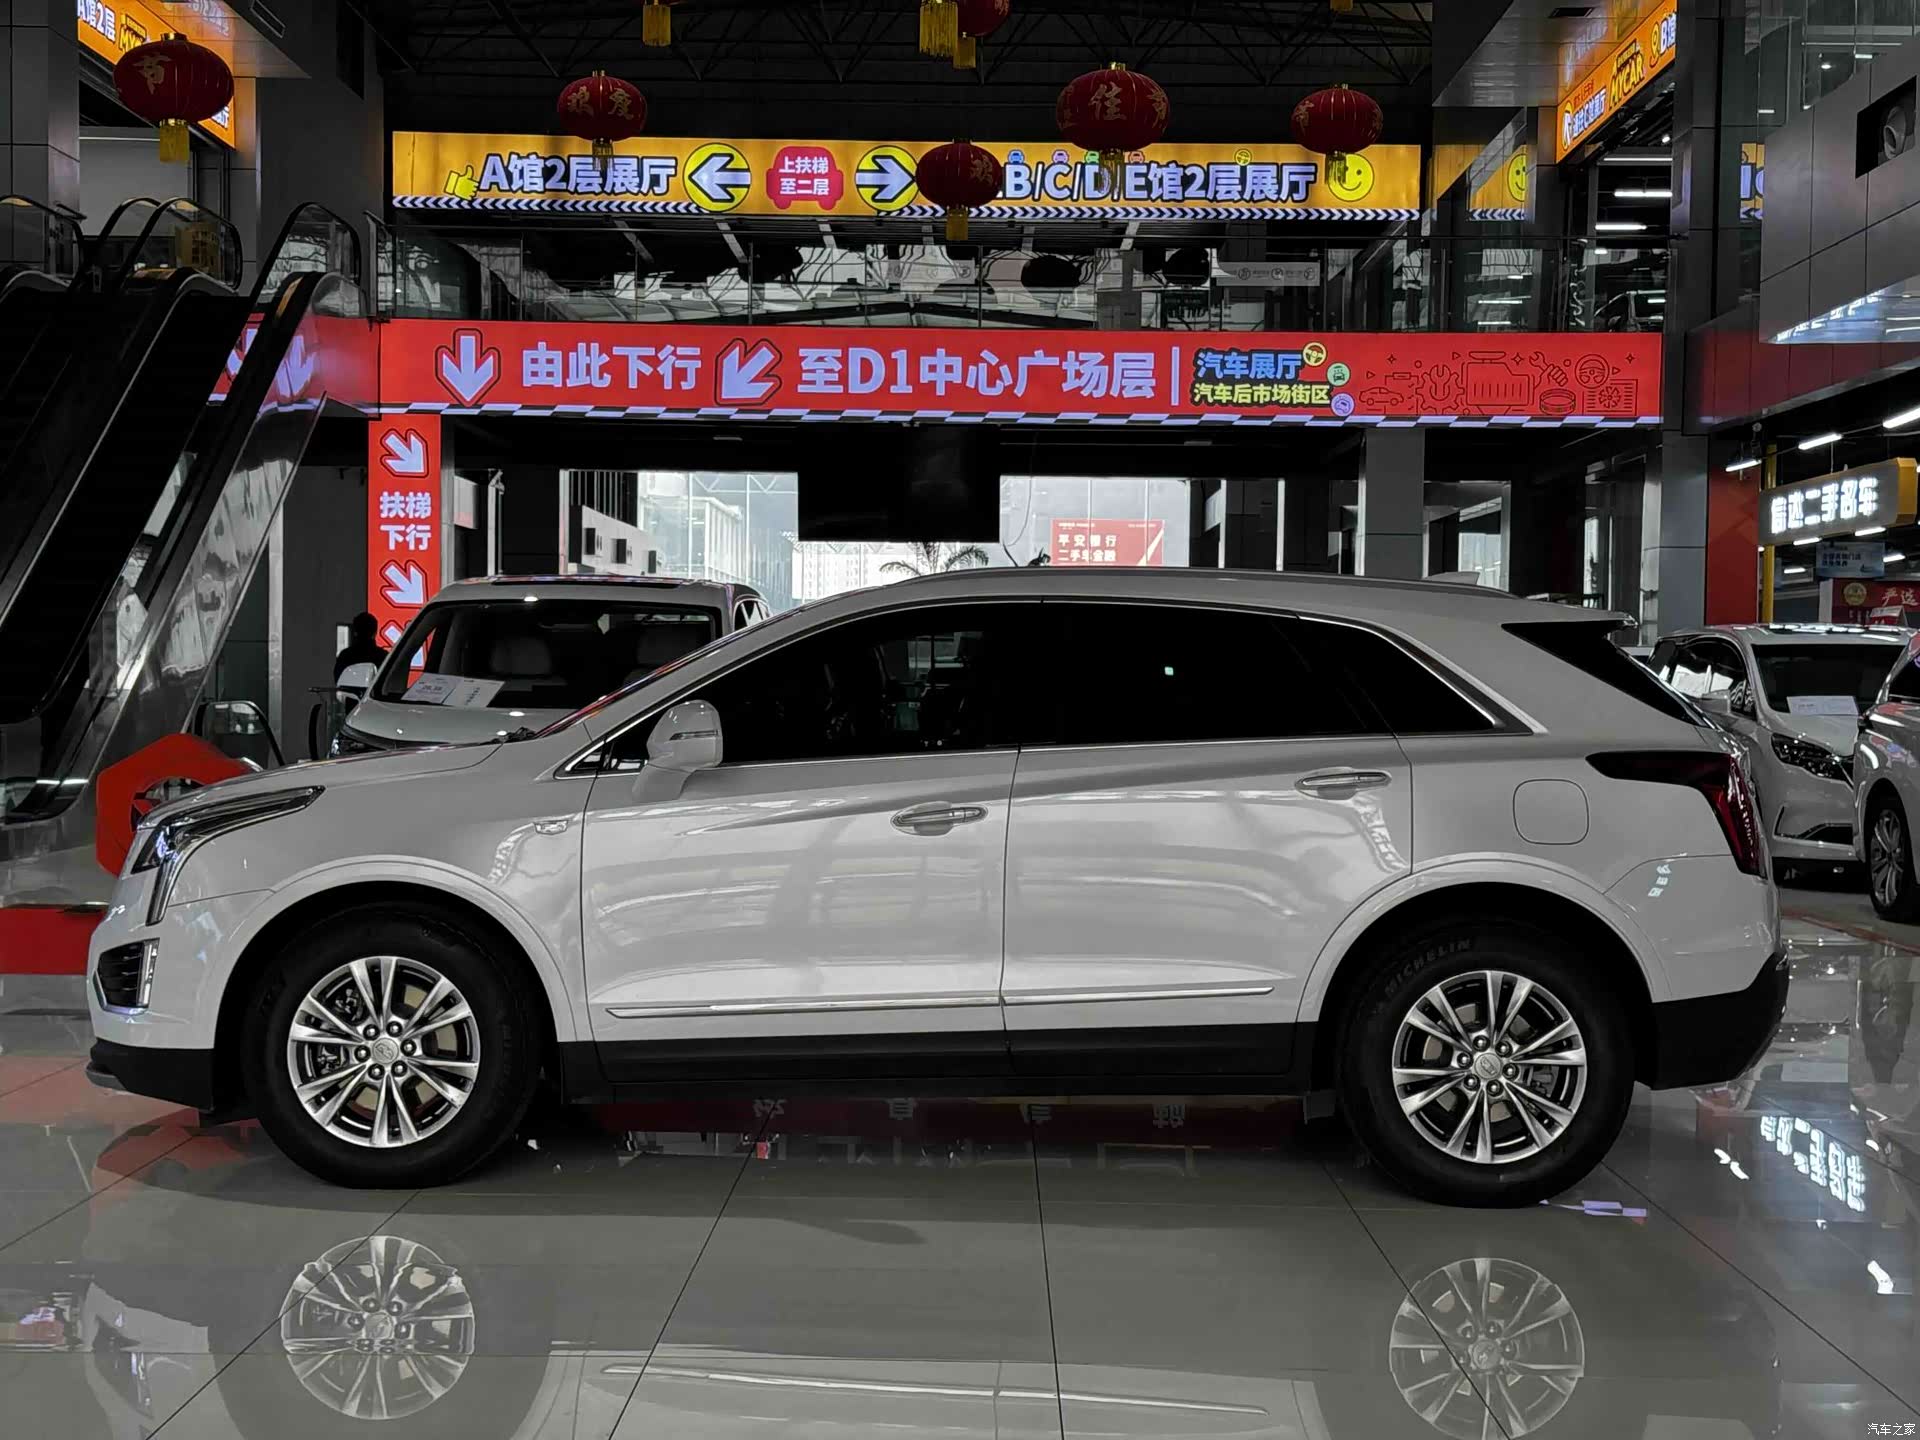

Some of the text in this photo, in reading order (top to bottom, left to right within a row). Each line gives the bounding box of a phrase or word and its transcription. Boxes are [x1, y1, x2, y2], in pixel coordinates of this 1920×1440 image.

[480, 152, 677, 194] A馆2层展厅
[779, 156, 829, 174] 上扶梯
[780, 178, 830, 195] 至二层
[522, 341, 1156, 399] 由此下行 至D1中心广场层
[1197, 352, 1303, 380] 汽车展厅
[1194, 383, 1331, 405] 汽车后市场街区
[380, 491, 431, 519] 扶梯
[380, 524, 431, 551] 下行
